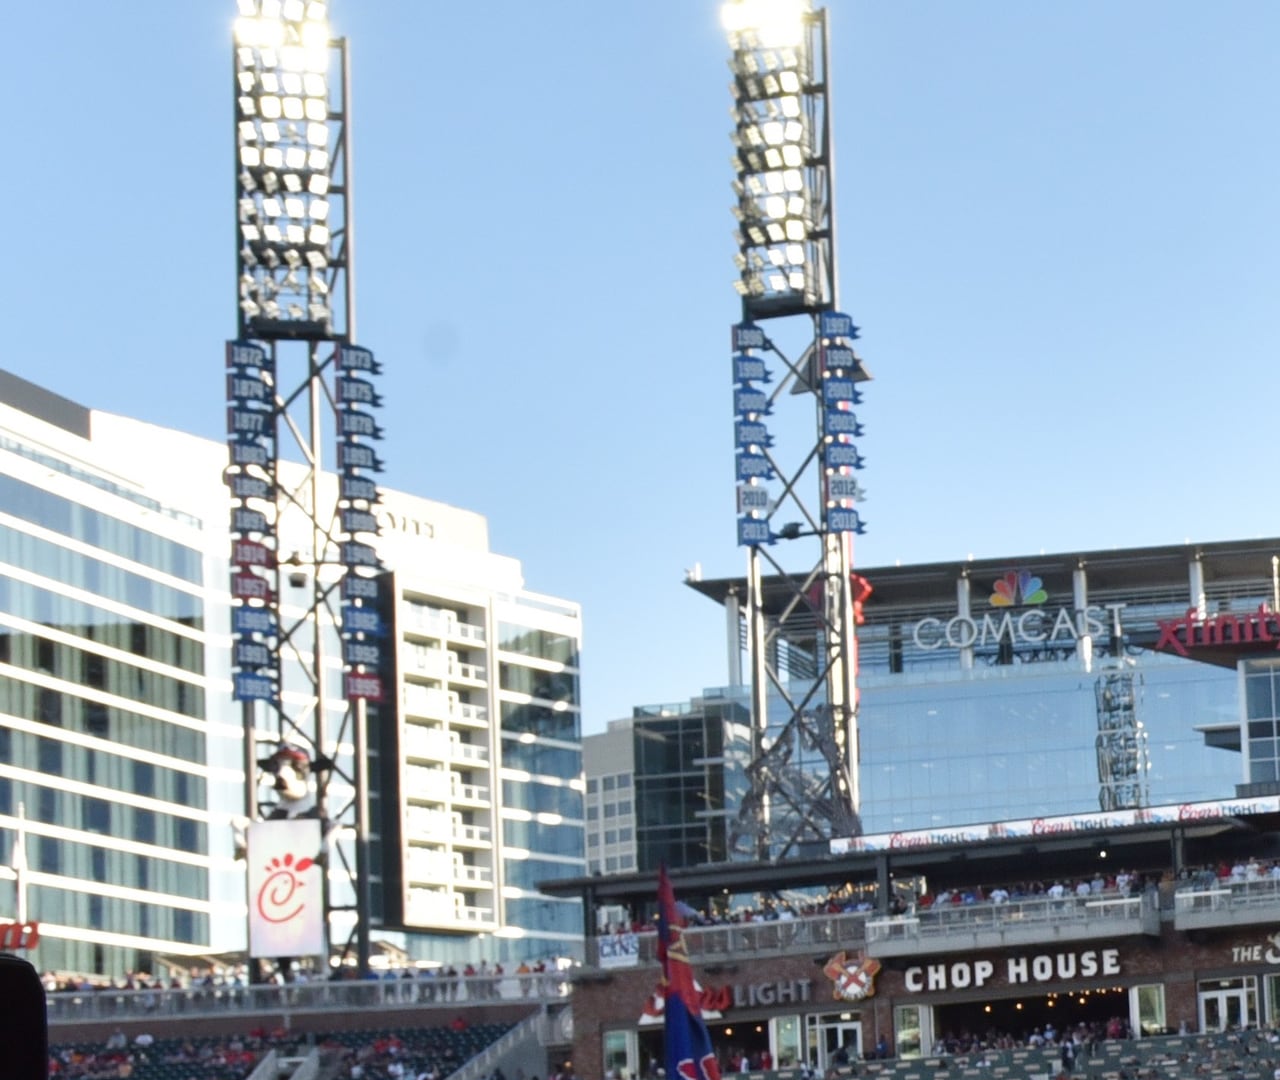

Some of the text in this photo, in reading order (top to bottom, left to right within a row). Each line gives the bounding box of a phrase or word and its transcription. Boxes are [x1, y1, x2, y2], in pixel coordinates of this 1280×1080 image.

[830, 480, 856, 496] 2012
[742, 490, 767, 507] 2010
[831, 513, 857, 530] 2018
[912, 602, 1128, 650] COMCAST
[1232, 946, 1262, 962] THE
[905, 960, 993, 992] CHOP
[1008, 949, 1121, 984] HOUSE
[733, 978, 813, 1008] LIGHT
